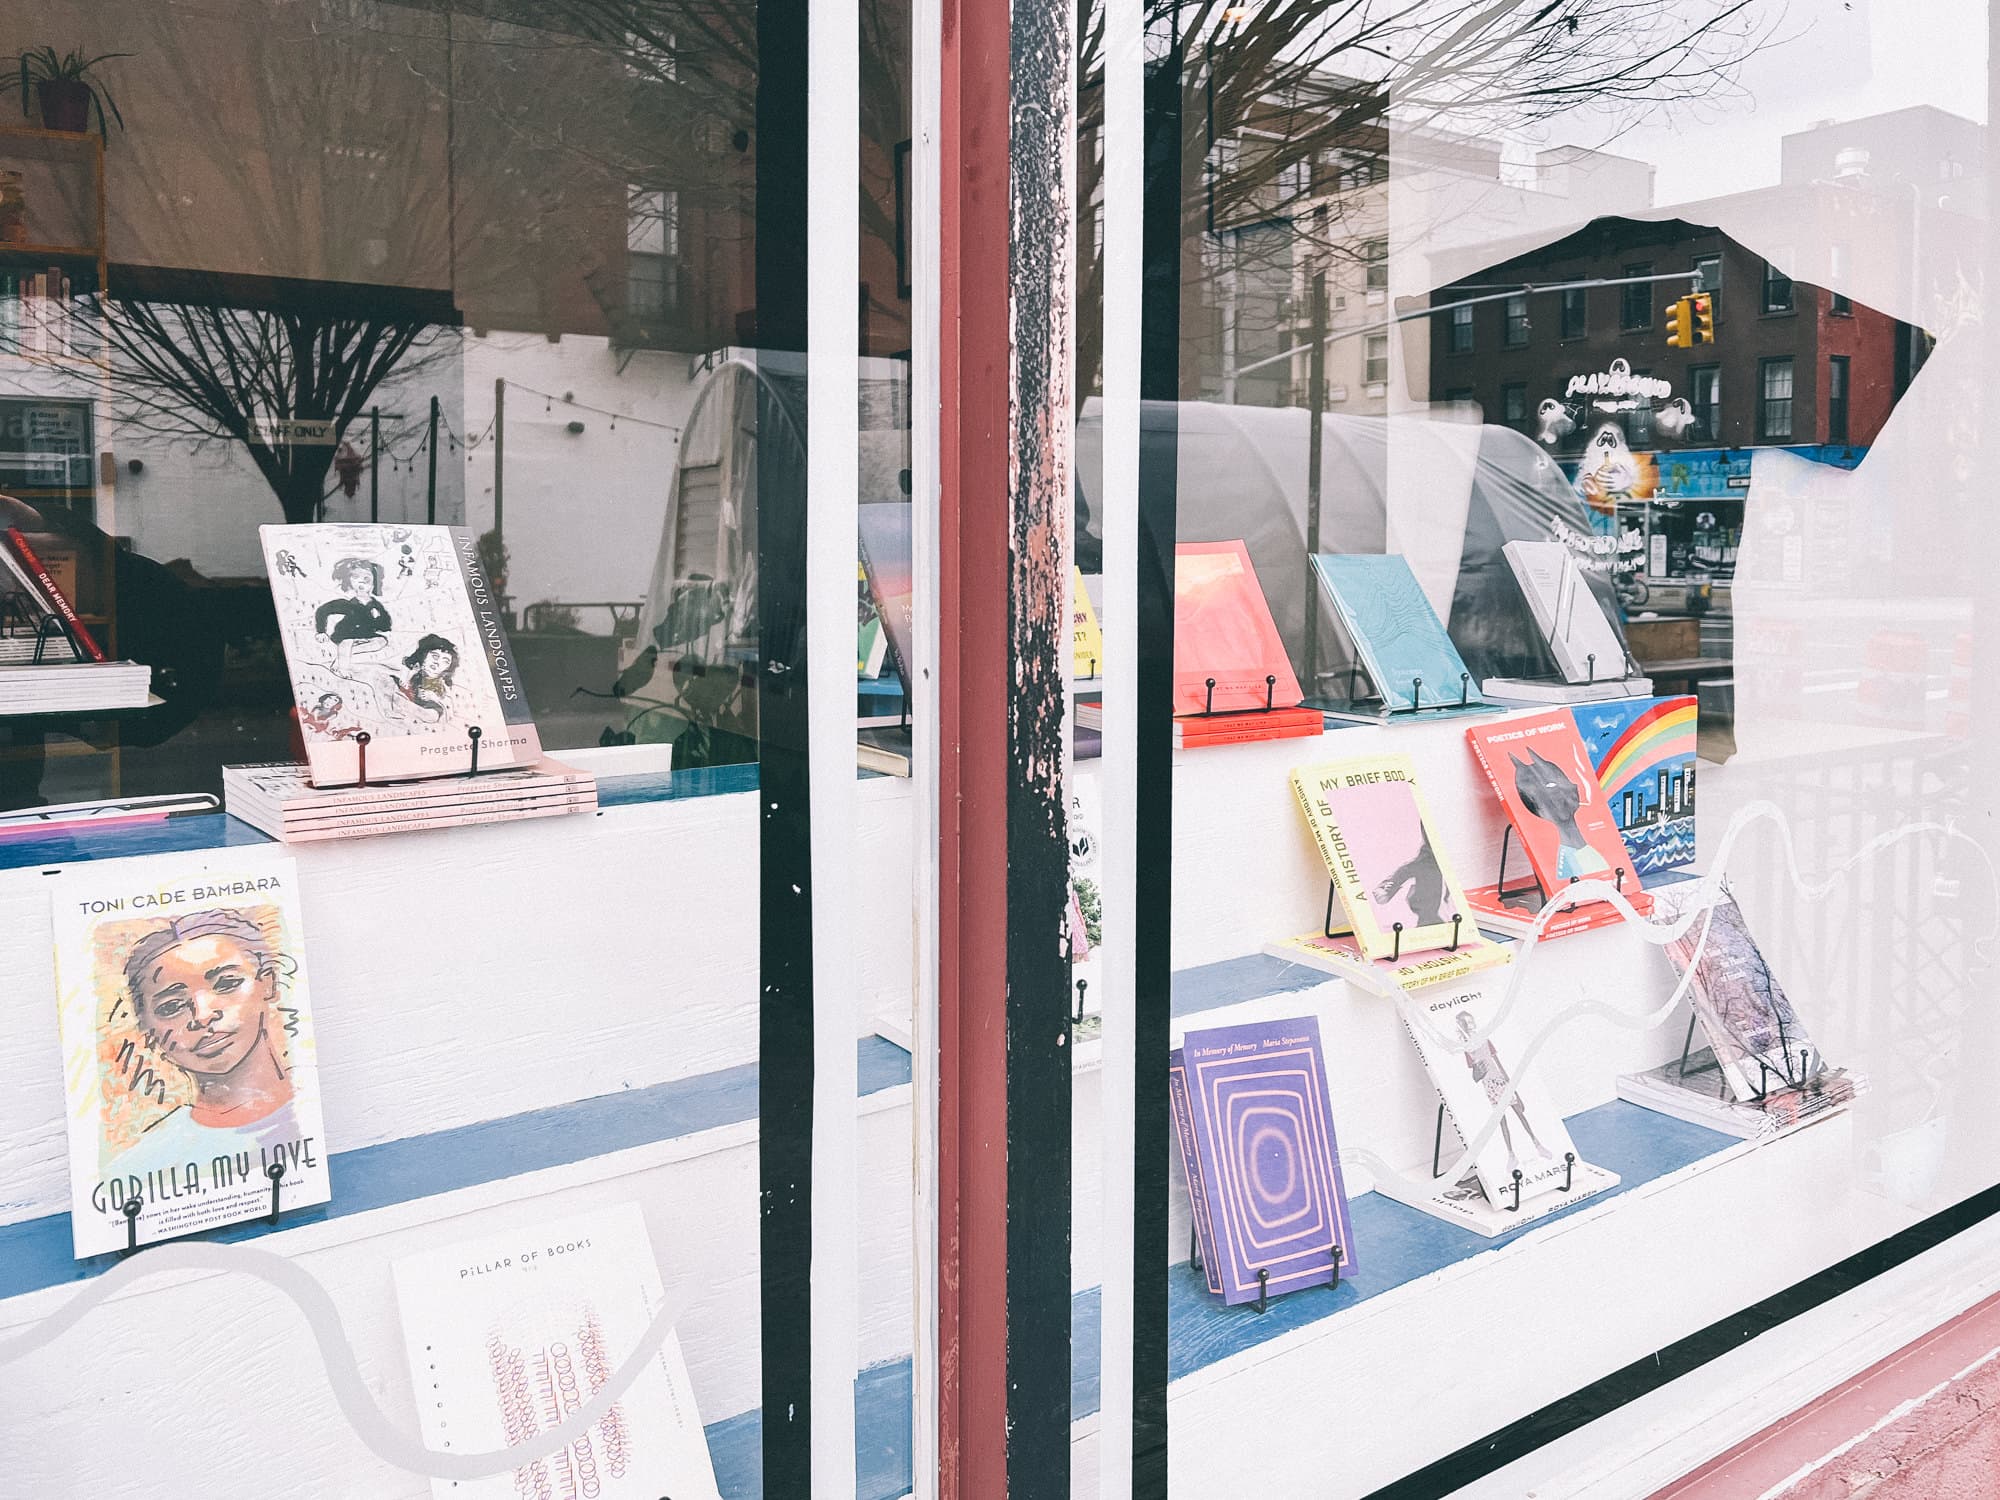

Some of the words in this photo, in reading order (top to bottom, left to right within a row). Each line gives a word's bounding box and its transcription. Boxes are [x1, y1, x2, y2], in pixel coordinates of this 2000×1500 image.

[294, 425, 327, 438] ONLY
[38, 572, 58, 594] DEAR
[52, 593, 78, 622] MEMORY
[458, 535, 489, 606] INFAMOUS
[480, 610, 518, 701] LANDSCAPES
[481, 736, 528, 750] Sharma
[1486, 730, 1525, 745] POETICS
[1526, 727, 1538, 738] OF
[1538, 722, 1567, 736] WORK
[1293, 778, 1300, 786] A
[1319, 777, 1340, 792] MY
[1345, 771, 1382, 787] BRIEF
[1383, 769, 1417, 786] BODY
[1471, 739, 1489, 770] POETICS
[1486, 769, 1493, 779] OF
[1490, 780, 1505, 802] WORK
[1296, 785, 1314, 818] HISTORY
[1316, 799, 1333, 817] OF
[1310, 818, 1318, 830] OF
[1314, 830, 1324, 843] MY
[1320, 843, 1334, 872] BRIEF
[1326, 823, 1361, 885] HISTORY
[1330, 867, 1343, 890] BODY
[79, 898, 125, 916] TONI
[132, 890, 186, 909] CADE
[191, 876, 281, 901] BAMBARA
[1355, 891, 1368, 902] A
[1416, 954, 1464, 975] HISTORY
[1194, 1049, 1201, 1058] In
[1202, 1046, 1227, 1058] Memory
[1227, 1043, 1235, 1055] of
[1234, 1042, 1258, 1053] Memory
[1263, 1039, 1281, 1049] Maria
[1435, 1087, 1454, 1120] ROYA
[91, 1162, 207, 1215] GORILLA,
[211, 1151, 250, 1189] MY
[261, 1137, 317, 1178] LOVE
[1498, 1175, 1533, 1196] ROYA
[181, 1203, 197, 1211] wake
[197, 1193, 243, 1208] understanding,
[289, 1178, 305, 1187] book
[165, 1215, 181, 1223] filled
[182, 1212, 196, 1220] with
[196, 1208, 210, 1217] both
[225, 1202, 237, 1210] and
[204, 1214, 223, 1223] POST
[222, 1209, 242, 1219] BOOK
[243, 1203, 268, 1214] WORLD
[520, 1250, 539, 1264] OF
[547, 1237, 592, 1258] BOOKS
